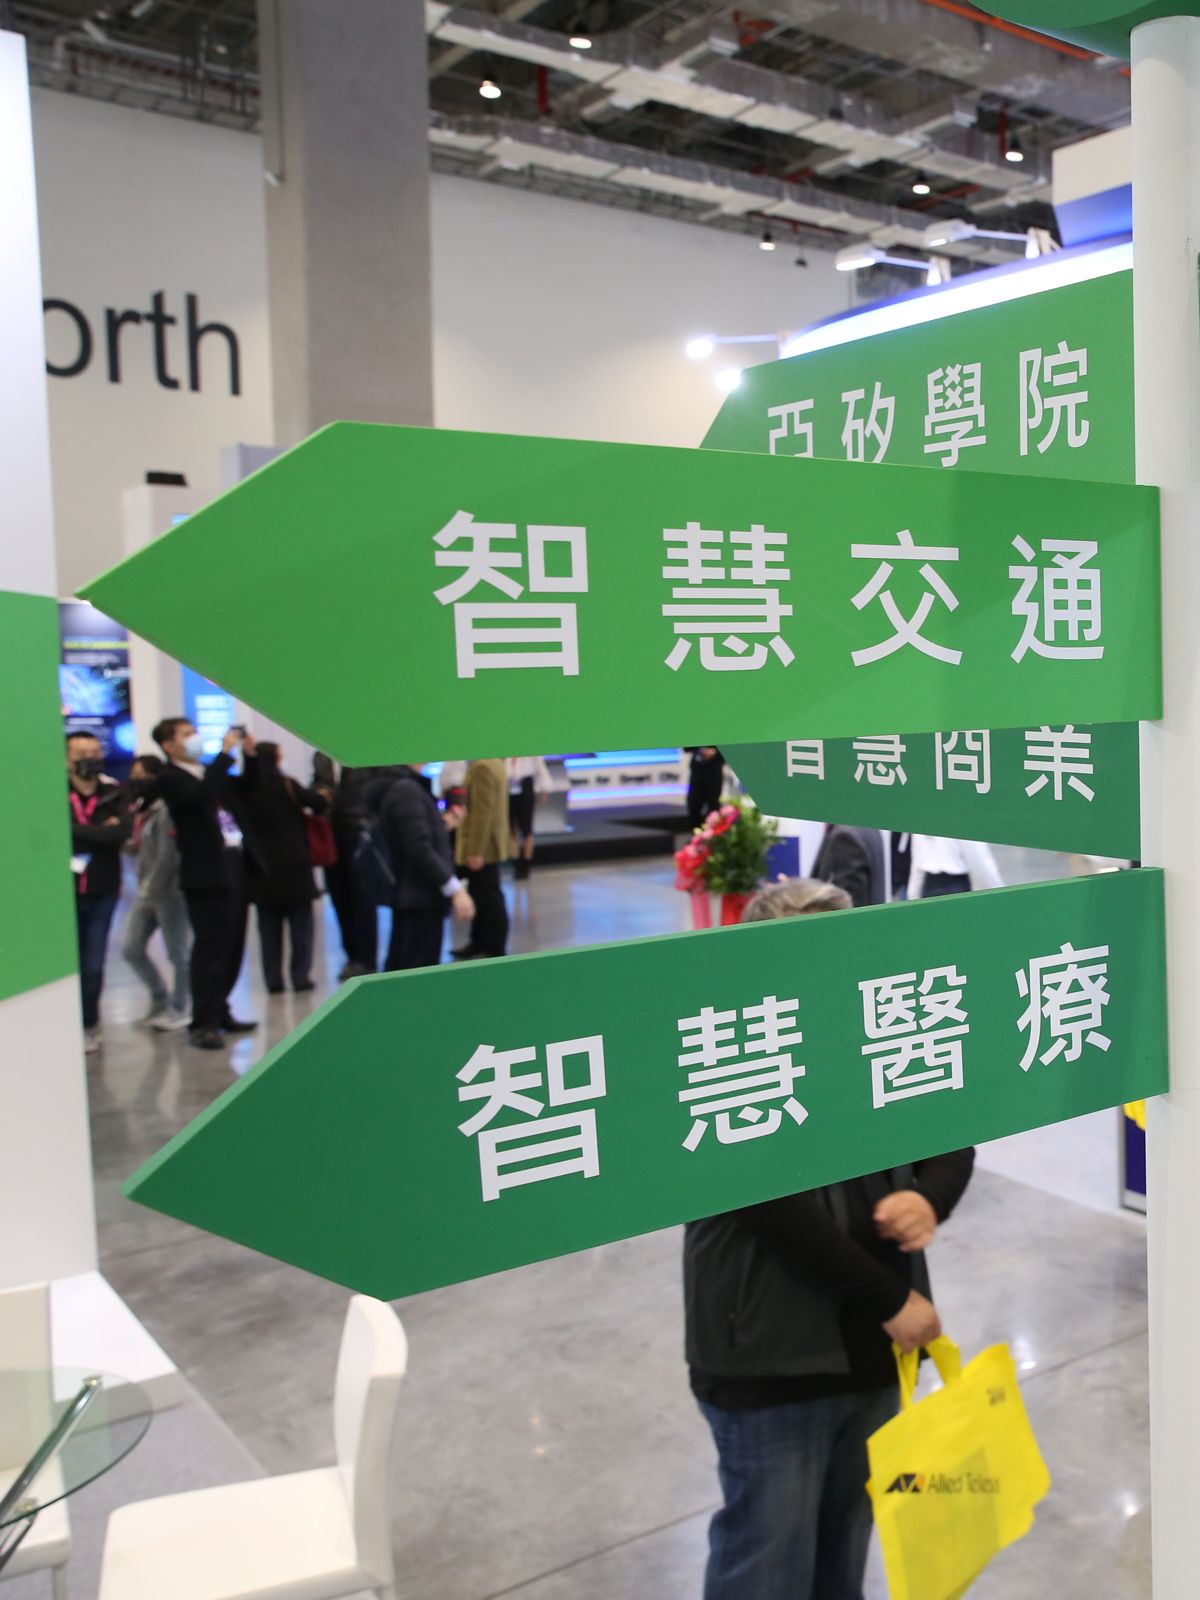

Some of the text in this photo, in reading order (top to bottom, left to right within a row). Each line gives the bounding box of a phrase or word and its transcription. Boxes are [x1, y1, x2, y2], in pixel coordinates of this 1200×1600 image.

[44, 290, 241, 396] orth
[767, 340, 1090, 467] 亞矽學院
[432, 510, 1105, 678] 智慧交通
[456, 942, 1112, 1202] 智慧醫療
